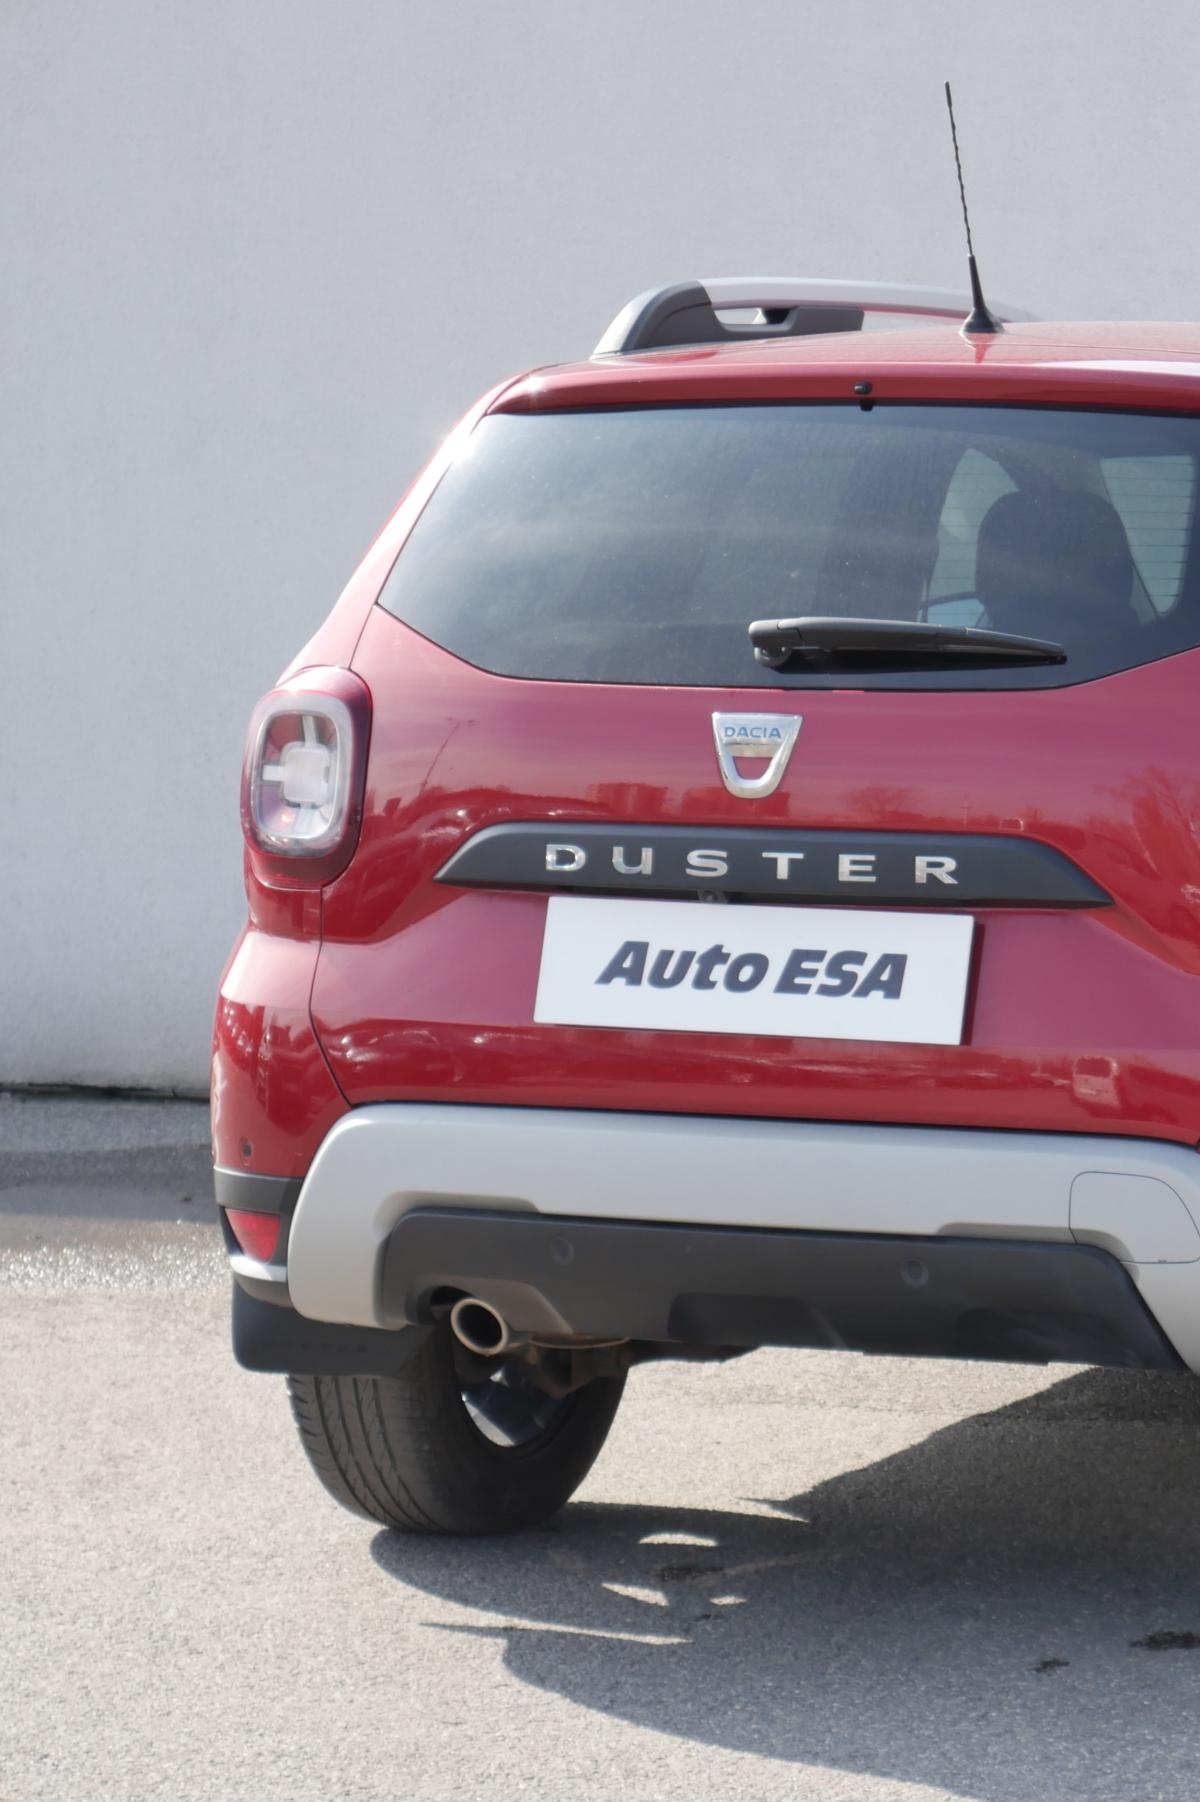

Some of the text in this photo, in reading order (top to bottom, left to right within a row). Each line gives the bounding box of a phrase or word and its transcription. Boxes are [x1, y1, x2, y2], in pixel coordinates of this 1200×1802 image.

[724, 726, 782, 739] DACIA
[545, 844, 959, 885] DUSTER
[594, 940, 908, 1000] Auto ESA
